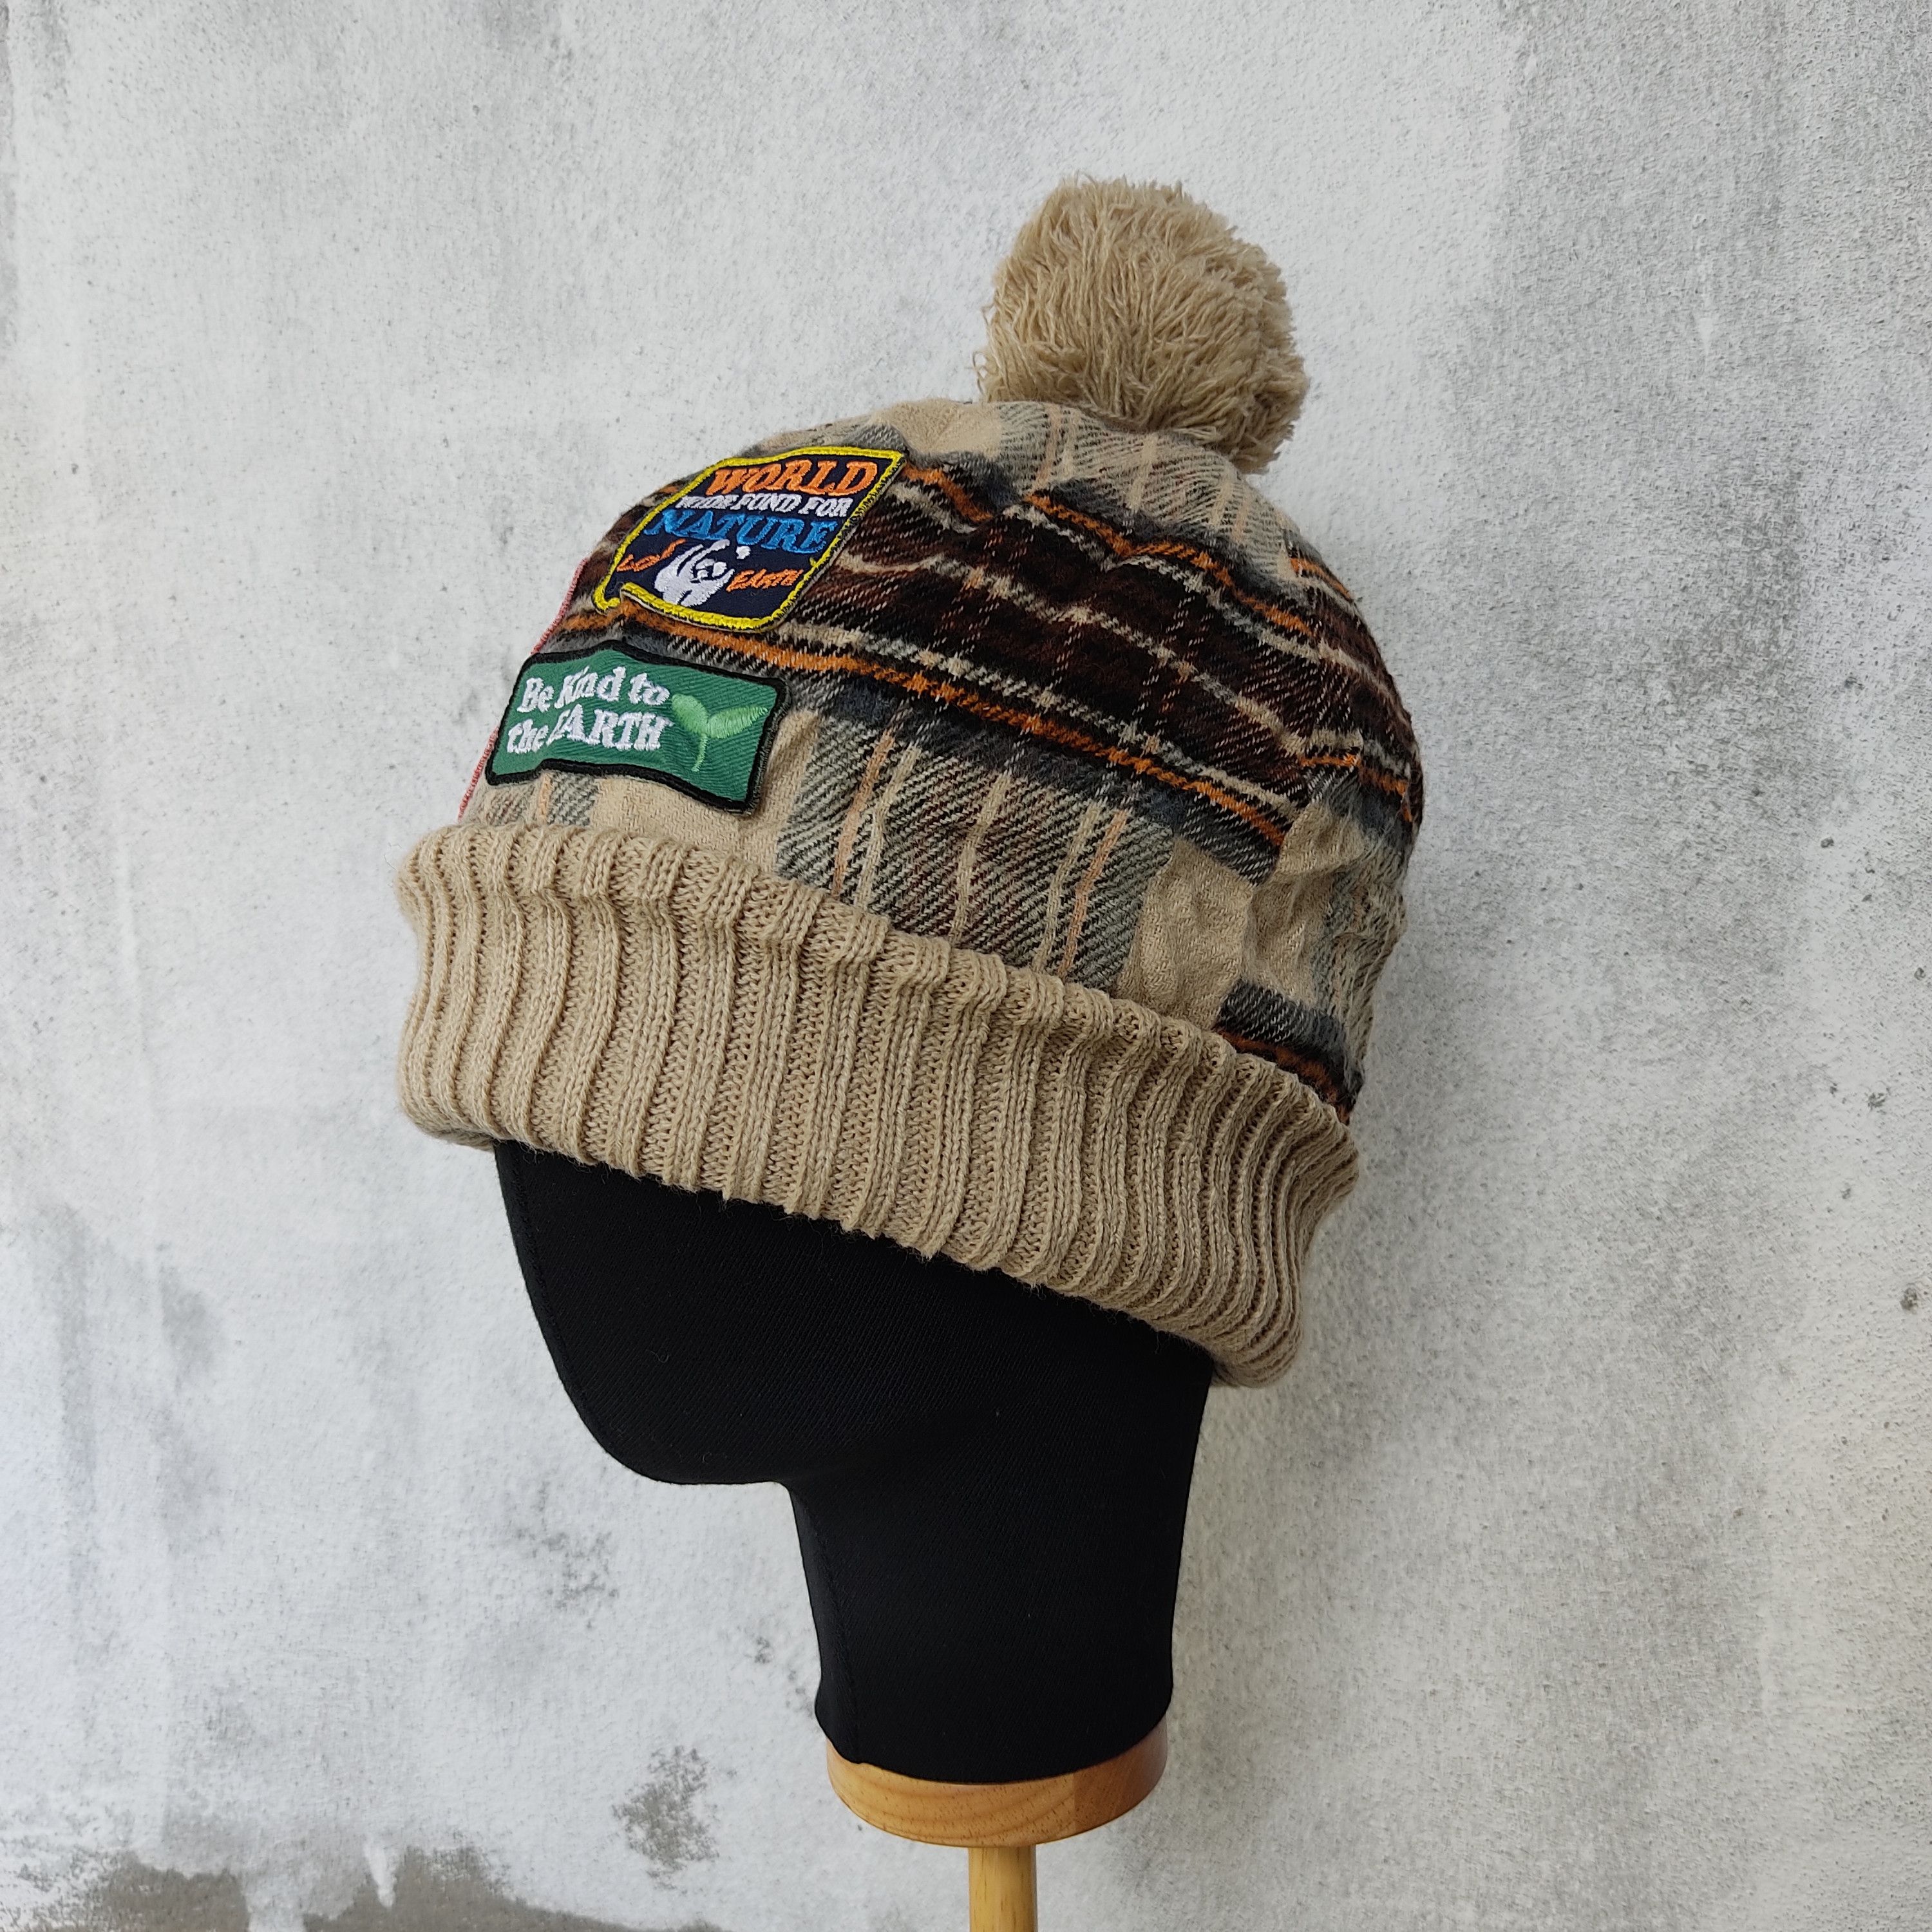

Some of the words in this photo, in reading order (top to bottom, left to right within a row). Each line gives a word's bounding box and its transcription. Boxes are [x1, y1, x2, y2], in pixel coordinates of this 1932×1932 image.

[707, 459, 878, 495] WORLD
[732, 493, 802, 513] FUND
[799, 497, 853, 516] FOR
[645, 509, 837, 553] NATURE
[516, 677, 554, 713] Be
[554, 666, 627, 708] Kind
[629, 673, 670, 705] to
[506, 719, 549, 753] the
[546, 703, 674, 751] EARTH
